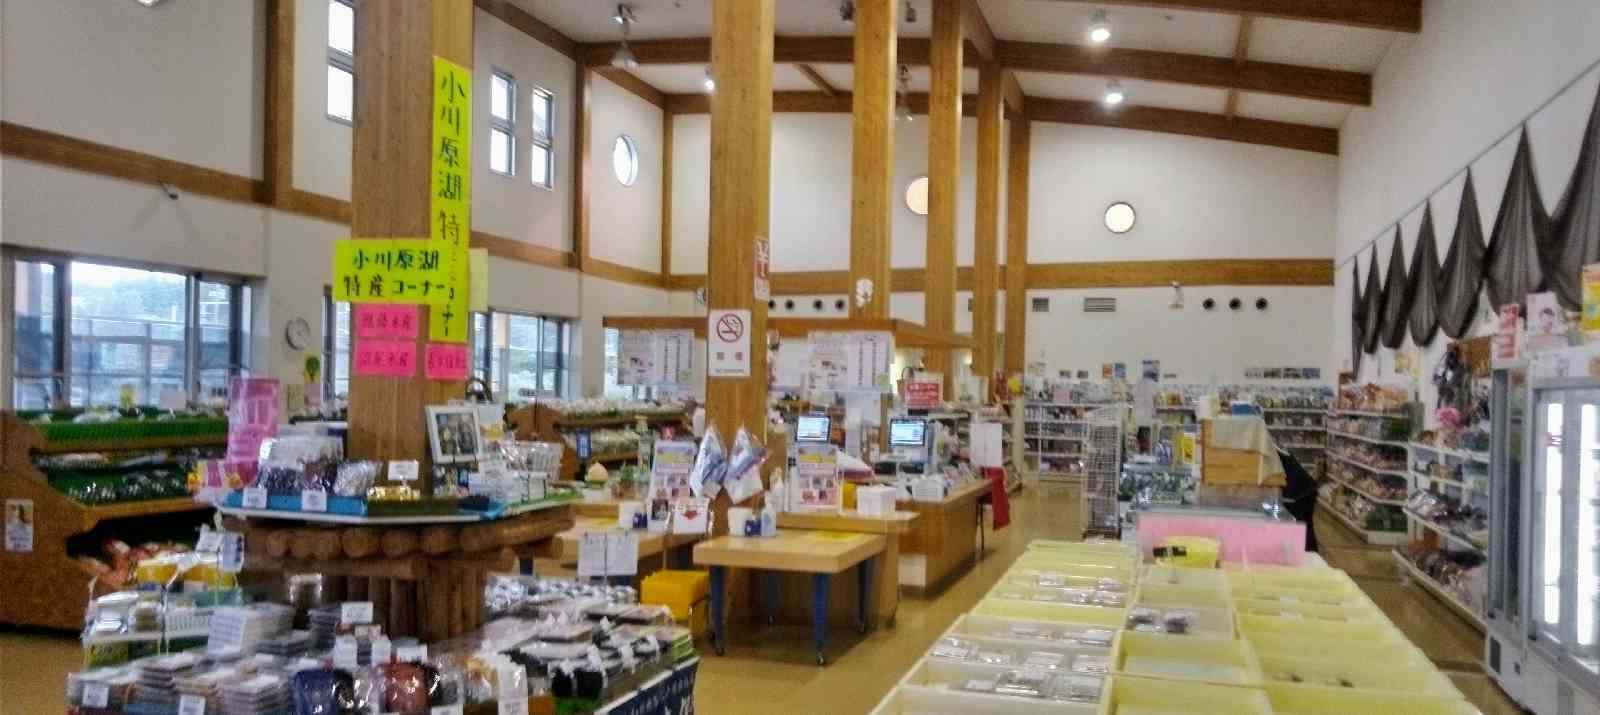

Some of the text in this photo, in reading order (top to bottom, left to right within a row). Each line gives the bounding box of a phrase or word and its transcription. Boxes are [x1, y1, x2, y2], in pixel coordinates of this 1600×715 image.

[353, 249, 439, 271] 小川原湖
[344, 273, 446, 297] 特産コーナー
